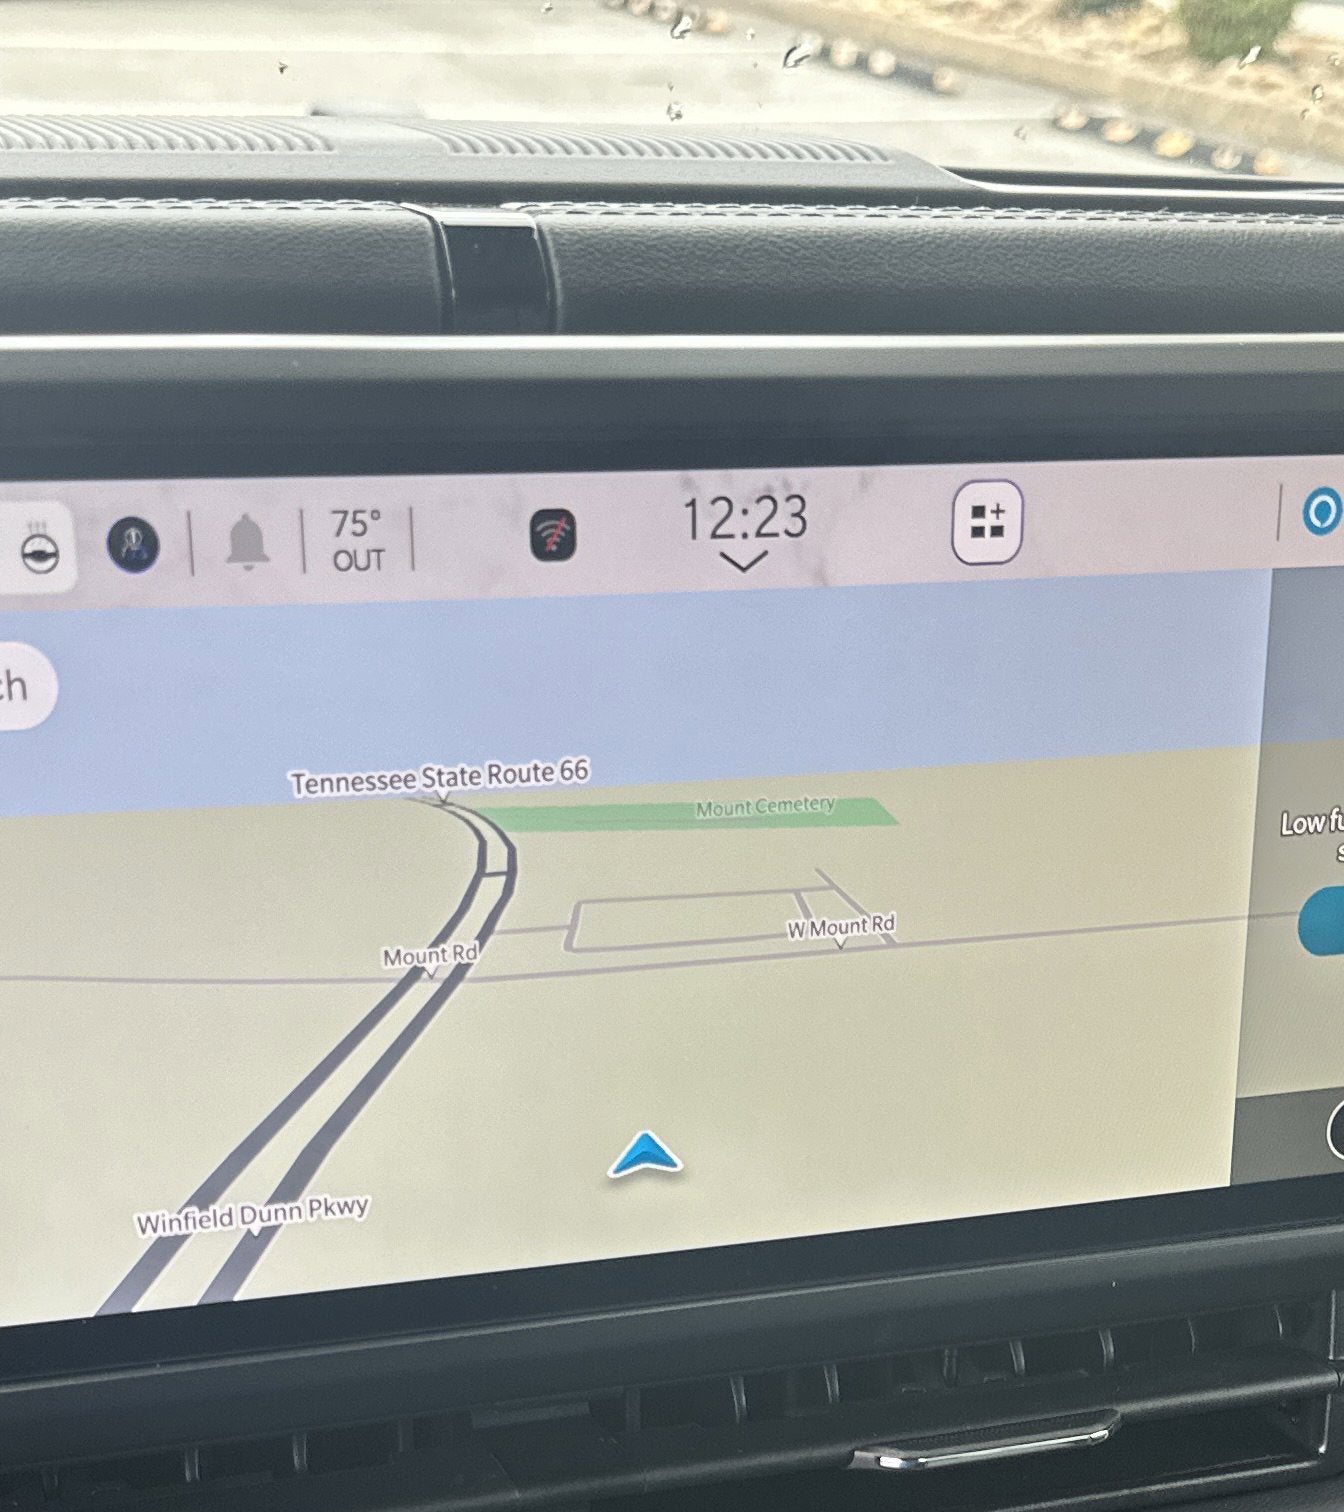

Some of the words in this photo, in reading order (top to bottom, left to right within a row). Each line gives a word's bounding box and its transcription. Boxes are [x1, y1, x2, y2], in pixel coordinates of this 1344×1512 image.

[331, 508, 381, 538] 75°
[684, 494, 808, 541] 12:23
[333, 549, 386, 573] OUT
[291, 768, 417, 796] Tennessee
[421, 764, 483, 790] State
[487, 762, 555, 785] Route
[559, 759, 590, 781] 66
[696, 799, 753, 818] Mount
[755, 794, 836, 818] Cemetery
[1281, 810, 1325, 836] Low
[788, 921, 805, 938] W
[810, 917, 868, 937] Mount
[872, 913, 895, 932] Rd
[382, 943, 448, 969] Mount
[450, 941, 478, 965] Rd
[137, 1206, 234, 1237] Winfield
[239, 1201, 304, 1229] Dunn
[309, 1193, 370, 1225] Pkwy
